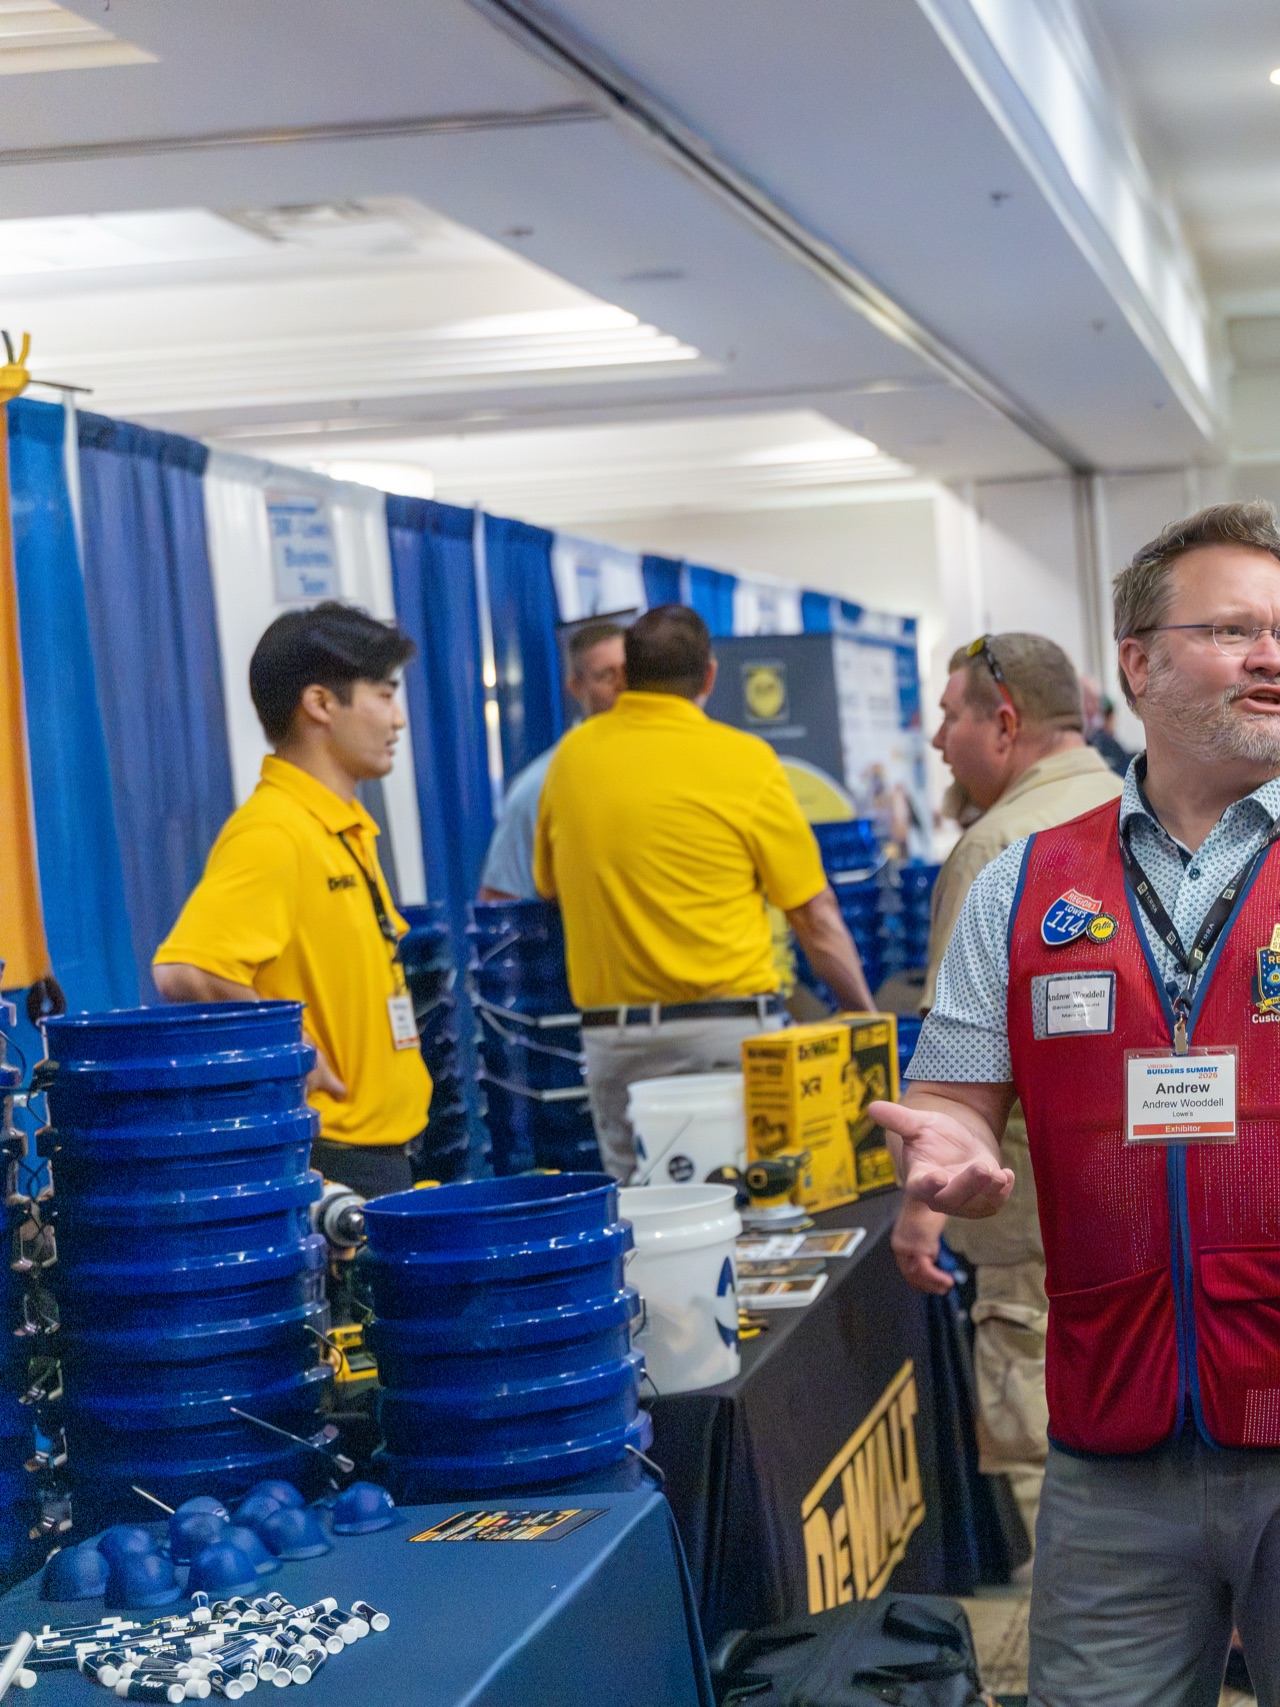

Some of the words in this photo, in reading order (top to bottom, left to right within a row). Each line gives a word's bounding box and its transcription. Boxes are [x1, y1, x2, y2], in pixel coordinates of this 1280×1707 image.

[1068, 893, 1092, 909] REGION
[1145, 890, 1158, 914] TERRA
[1046, 910, 1085, 936] 114
[1197, 922, 1215, 950] TERRA
[1048, 993, 1070, 1001] Andrew
[1072, 990, 1105, 999] Wooddell
[1155, 1082, 1210, 1095] Andrew
[1142, 1099, 1178, 1109] Andrew
[1180, 1097, 1224, 1108] Wooddell
[1172, 1110, 1194, 1118] Lowe's
[1165, 1124, 1202, 1133] Exhibitor
[294, 1606, 316, 1619] PRO
